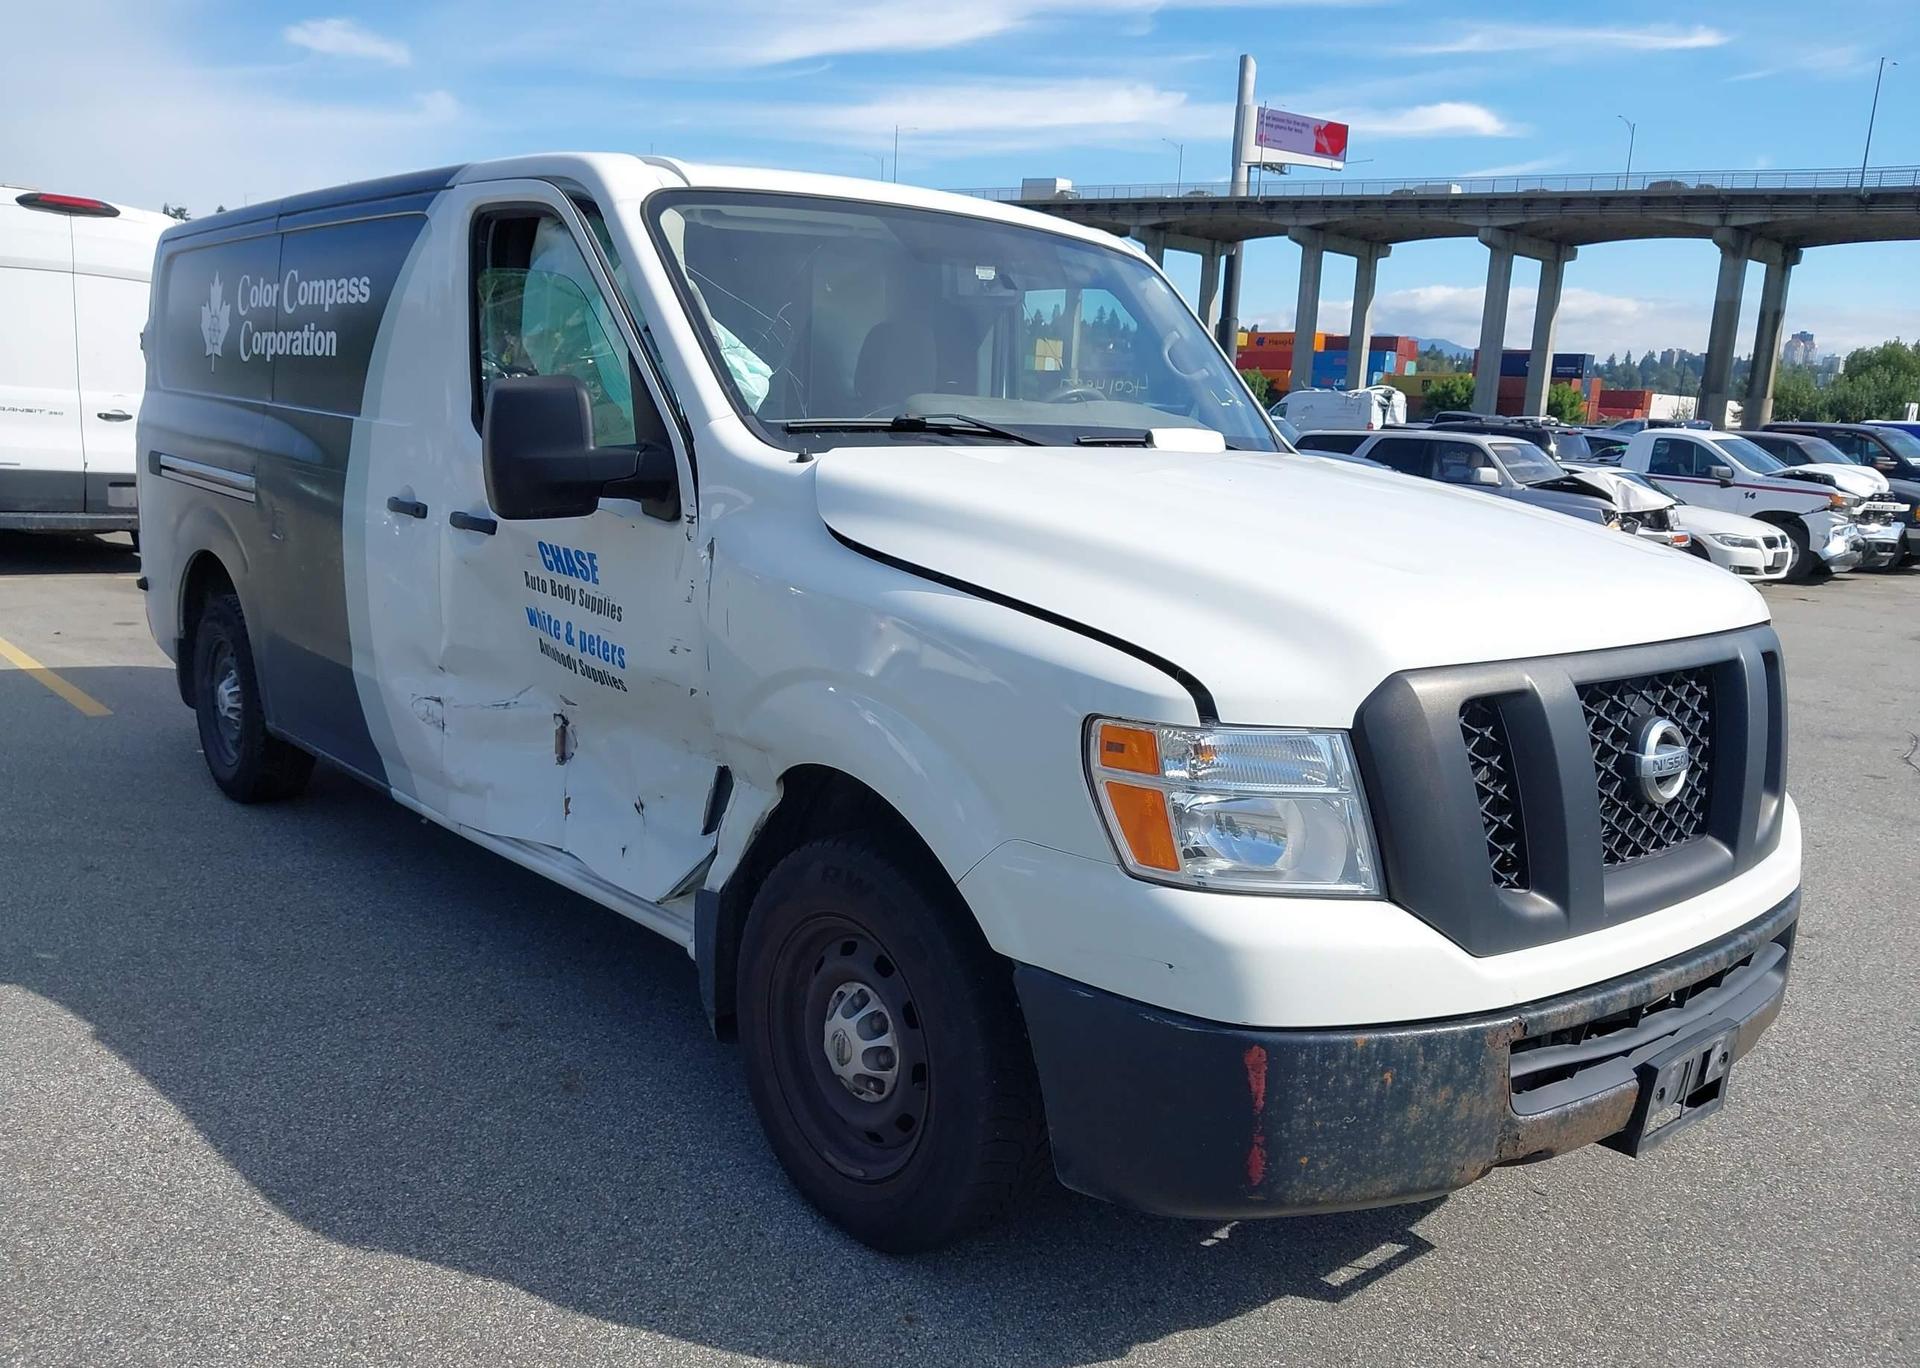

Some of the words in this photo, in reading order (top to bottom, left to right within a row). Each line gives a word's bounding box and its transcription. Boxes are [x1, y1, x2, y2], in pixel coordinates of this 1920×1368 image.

[238, 275, 279, 315] Color
[283, 270, 370, 313] Compass
[240, 321, 336, 361] Corporation
[0, 406, 46, 414] RANSIT
[1744, 491, 1756, 500] 14
[538, 541, 599, 585] CHASE
[524, 571, 547, 595] Auto
[550, 579, 577, 605] Body
[579, 588, 623, 622] Supplies
[525, 606, 561, 640] white
[565, 621, 576, 647] &
[579, 630, 626, 669] peters
[539, 637, 578, 675] Autobody
[578, 658, 628, 692] Supplies
